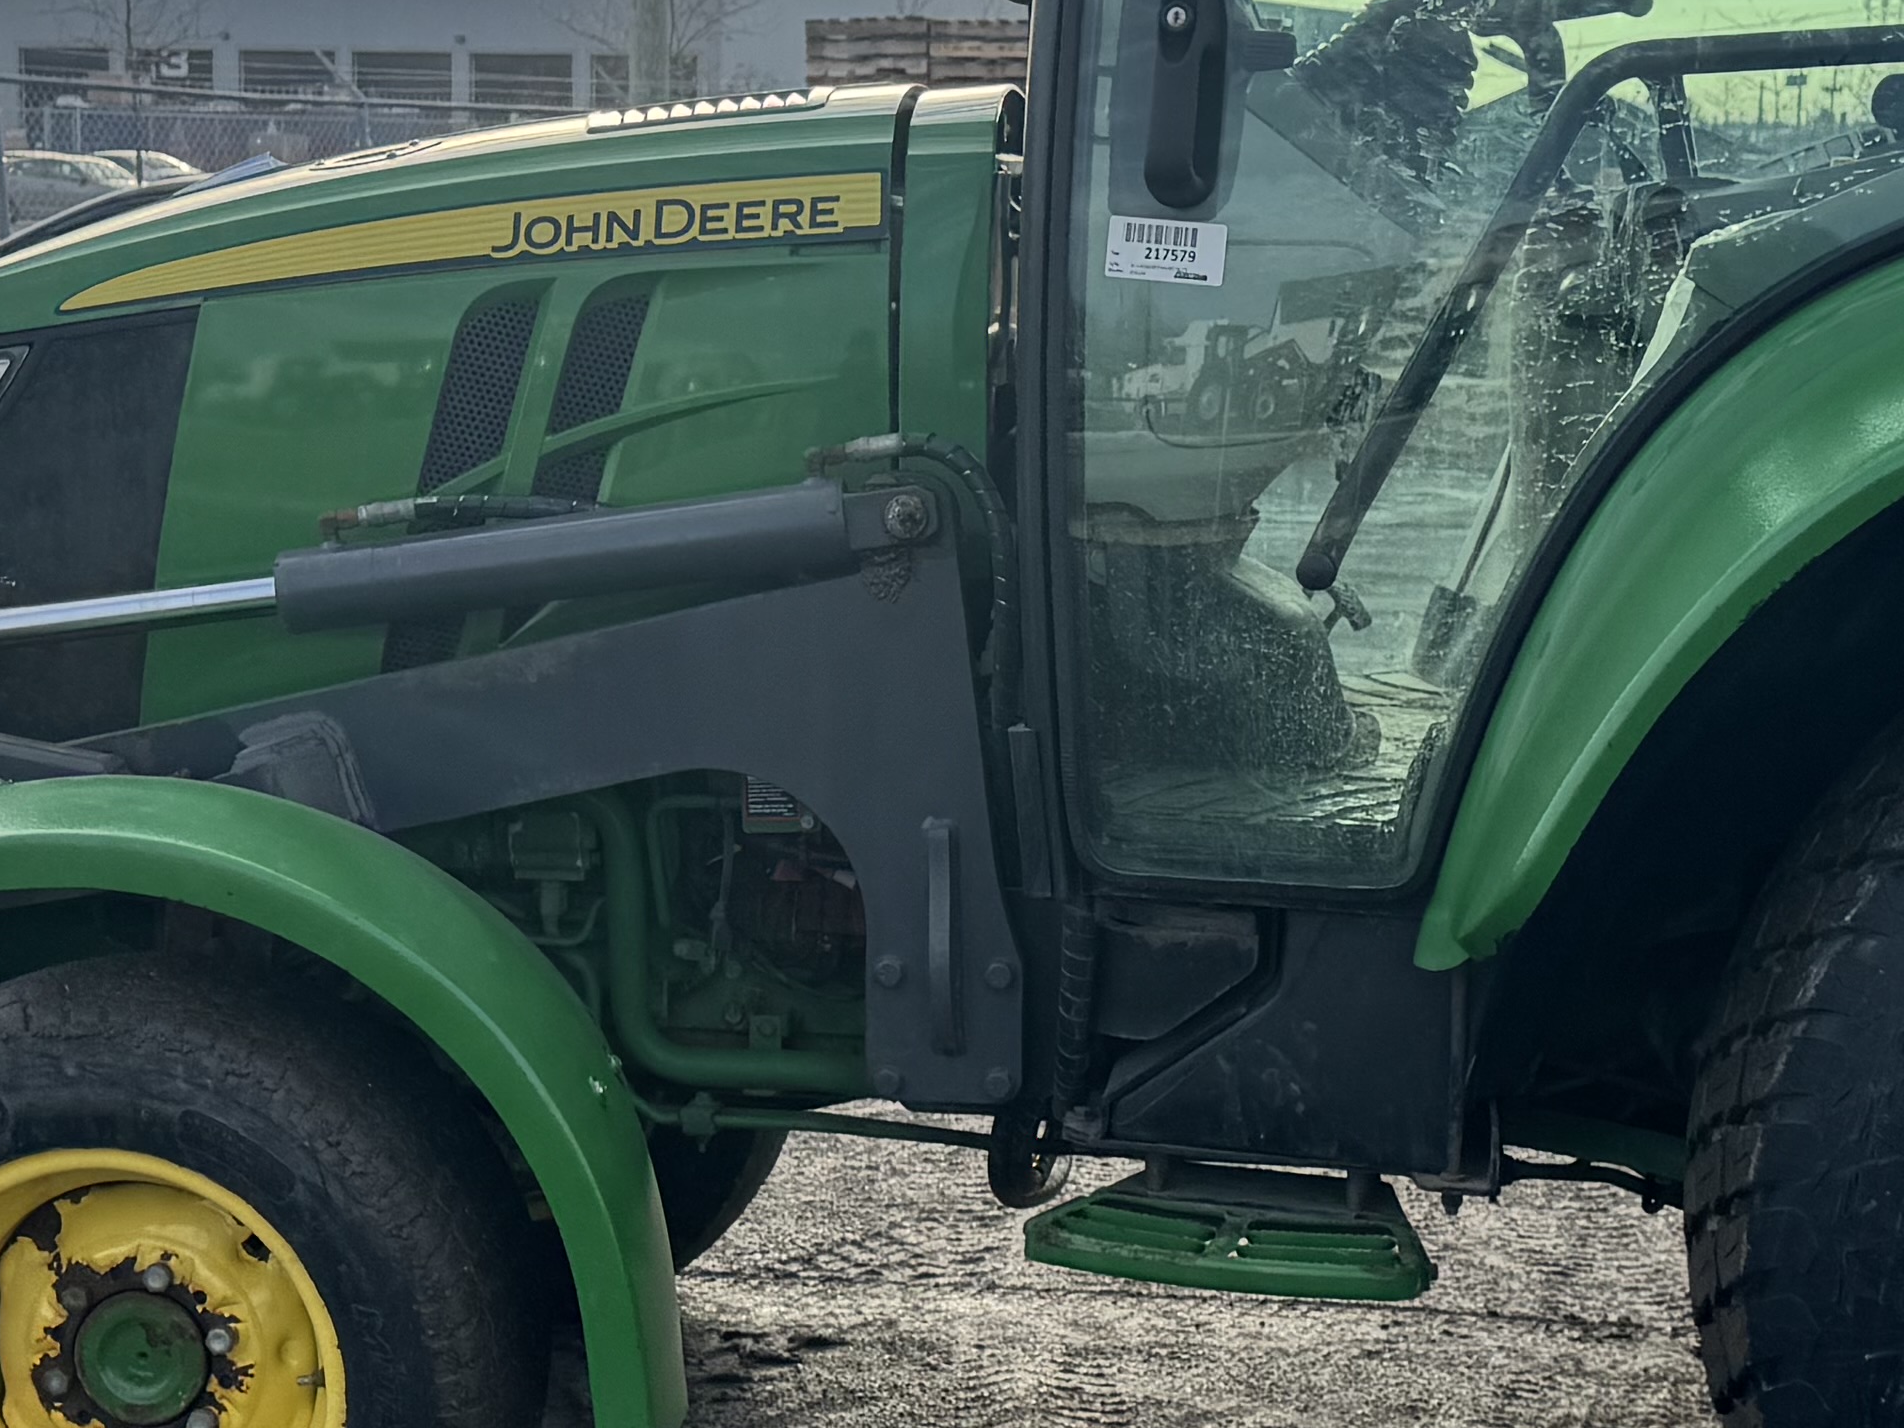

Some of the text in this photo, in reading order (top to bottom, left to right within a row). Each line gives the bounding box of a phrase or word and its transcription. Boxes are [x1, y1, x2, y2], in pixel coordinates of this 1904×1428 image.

[491, 195, 840, 253] JOHN DEERE
[1144, 247, 1196, 262] 217579
